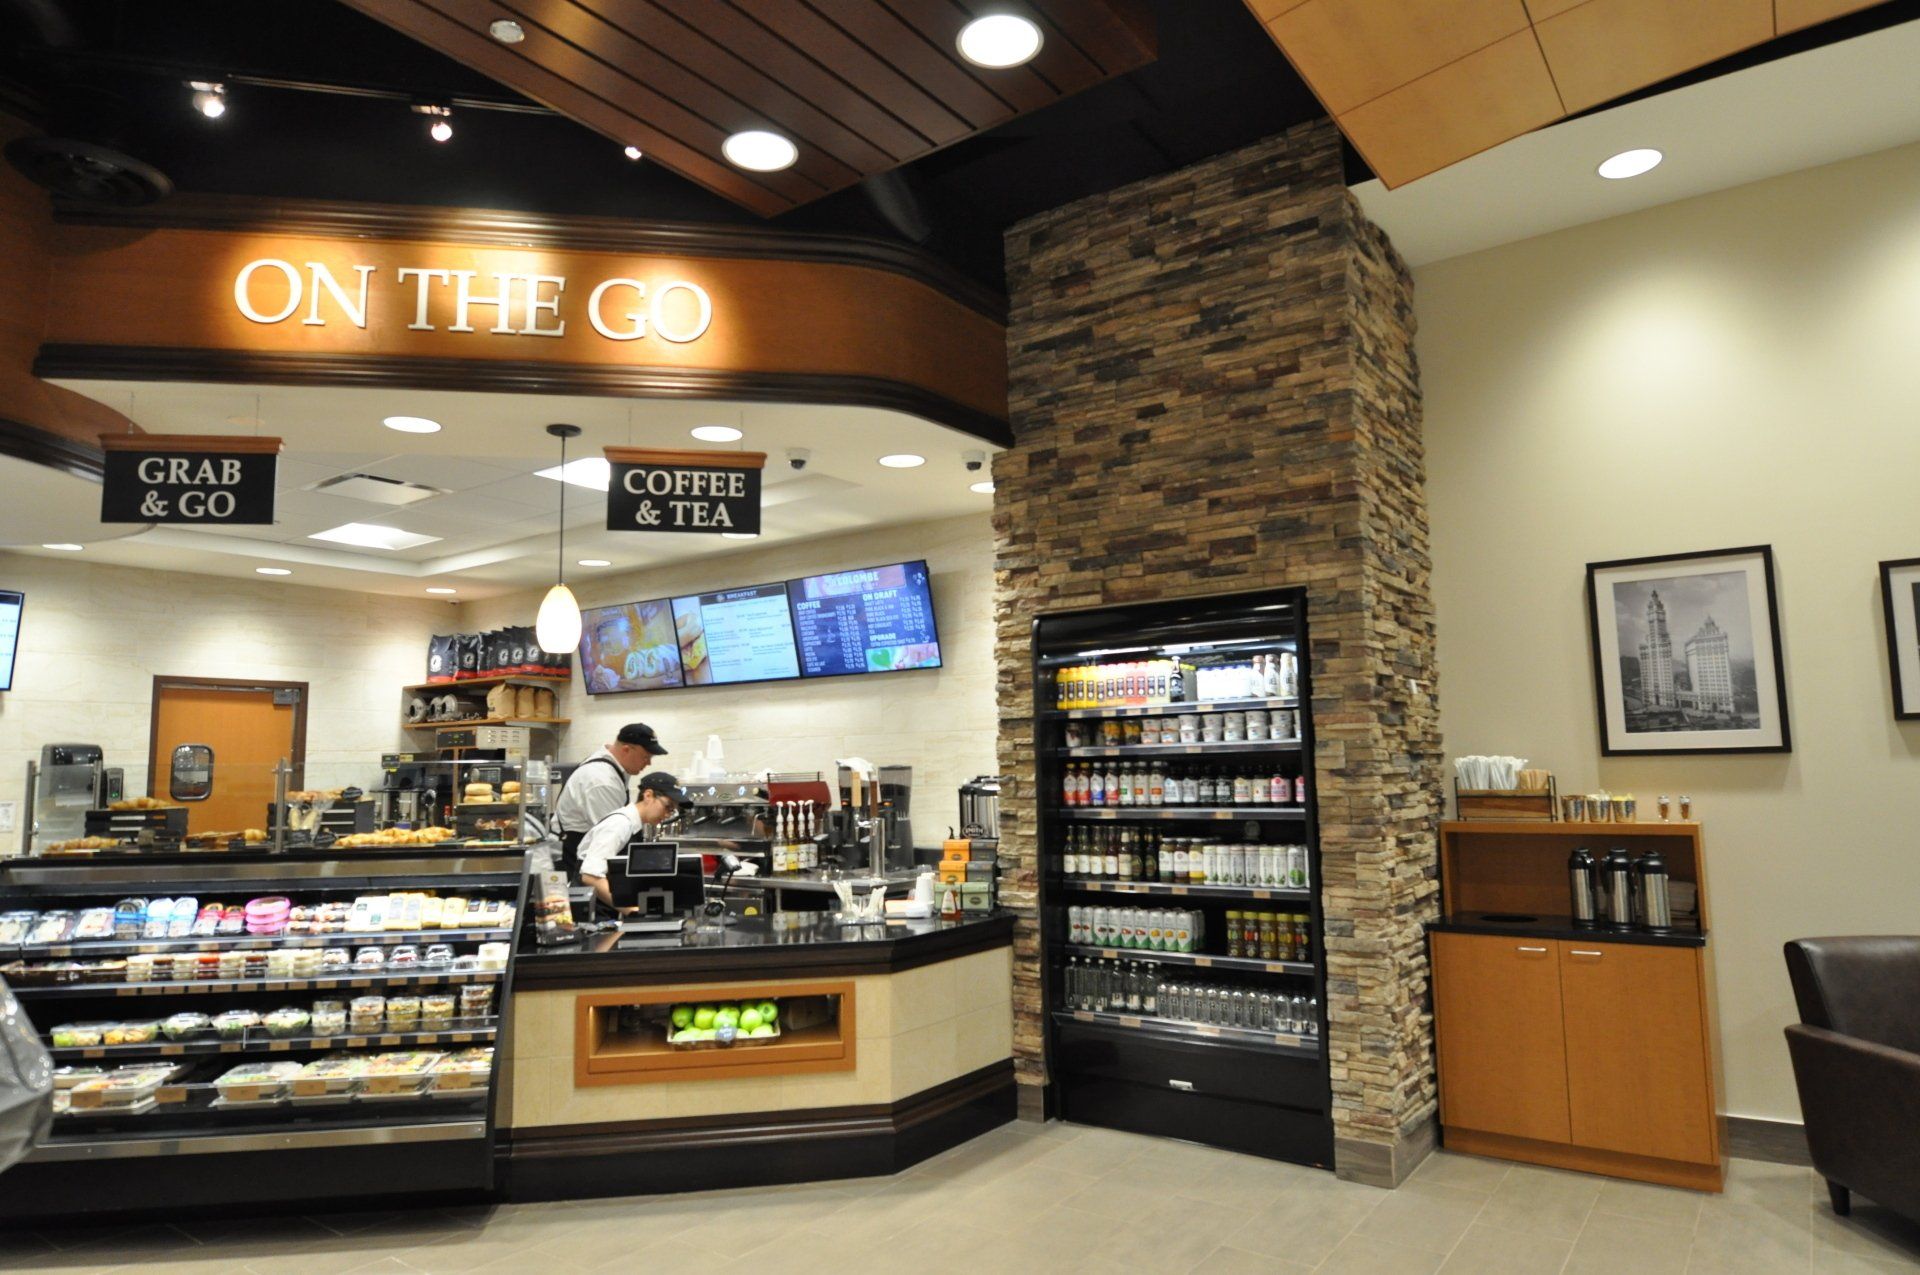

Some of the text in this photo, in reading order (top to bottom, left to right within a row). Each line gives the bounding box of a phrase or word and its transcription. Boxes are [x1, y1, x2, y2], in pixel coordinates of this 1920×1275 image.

[234, 258, 713, 343] ON THE GO
[138, 457, 242, 485] GRAB
[623, 469, 745, 497] COFFEE
[140, 490, 236, 518] & GO
[635, 500, 734, 527] & TEA
[726, 590, 757, 600] BREAKFAST
[796, 600, 821, 611] COFFEE
